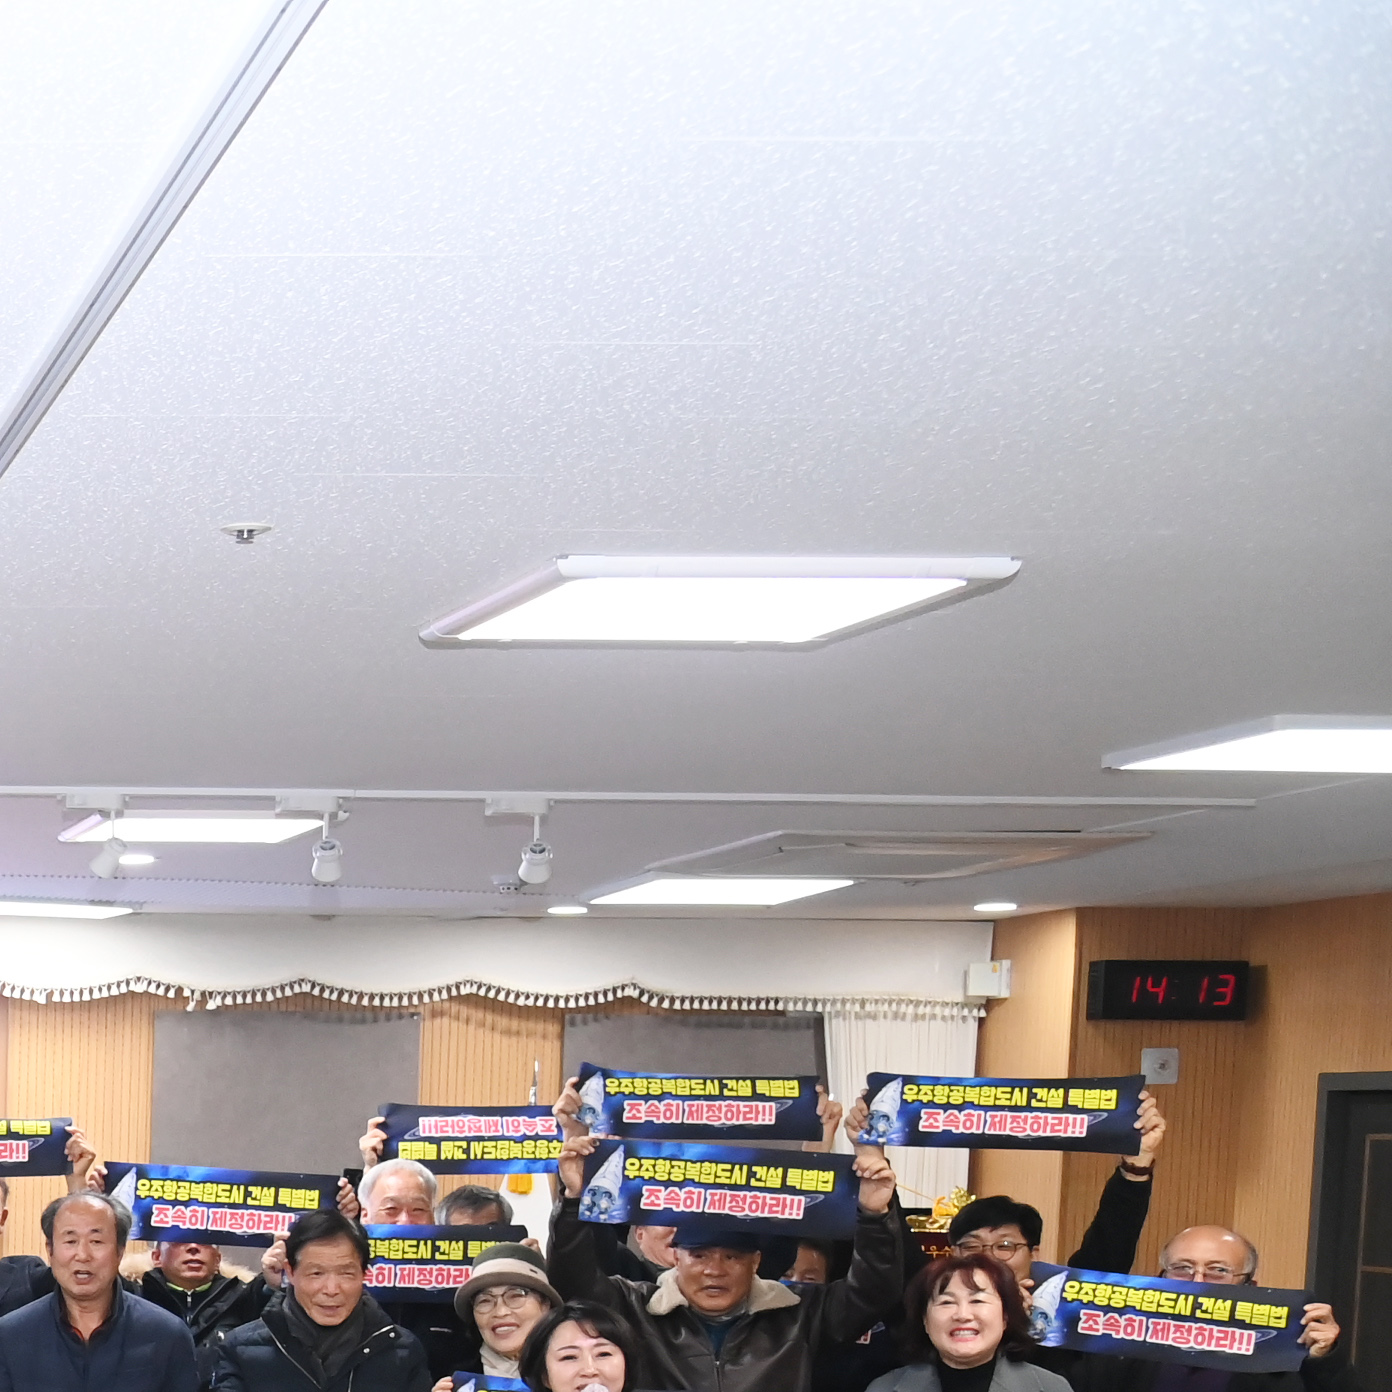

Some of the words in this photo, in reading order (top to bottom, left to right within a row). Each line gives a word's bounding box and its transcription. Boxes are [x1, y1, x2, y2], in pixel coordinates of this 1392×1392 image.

[606, 1078, 720, 1096] 우주항공복합도시
[723, 1079, 753, 1097] 건설
[756, 1079, 800, 1098] 특별법
[903, 1084, 1029, 1107] 우주항공복합도시
[1031, 1087, 1065, 1109] 건설
[1068, 1088, 1118, 1110] 특별법
[623, 1100, 683, 1123] 조속히
[683, 1101, 776, 1125] 제정하라!!
[919, 1110, 985, 1133] 조속히
[985, 1112, 1091, 1138] 제정하라!!
[11, 1121, 52, 1136] 특별법
[624, 1157, 749, 1186] 우주항공복합도시
[750, 1165, 784, 1189] 건설
[786, 1167, 835, 1193] 특별법
[136, 1178, 245, 1205] 우주항공복합도시
[247, 1185, 276, 1207] 건설
[278, 1187, 320, 1210] 특별법
[640, 1186, 705, 1212] 조속히
[704, 1190, 805, 1219] 제정하라!!
[151, 1205, 208, 1229] 조속히
[1063, 1280, 1195, 1316] 우주항공복합도시
[1196, 1296, 1233, 1322] 건설
[1234, 1301, 1289, 1329] 특별법
[1078, 1310, 1146, 1341] 조속히
[1146, 1319, 1256, 1355] 제정하라!!
